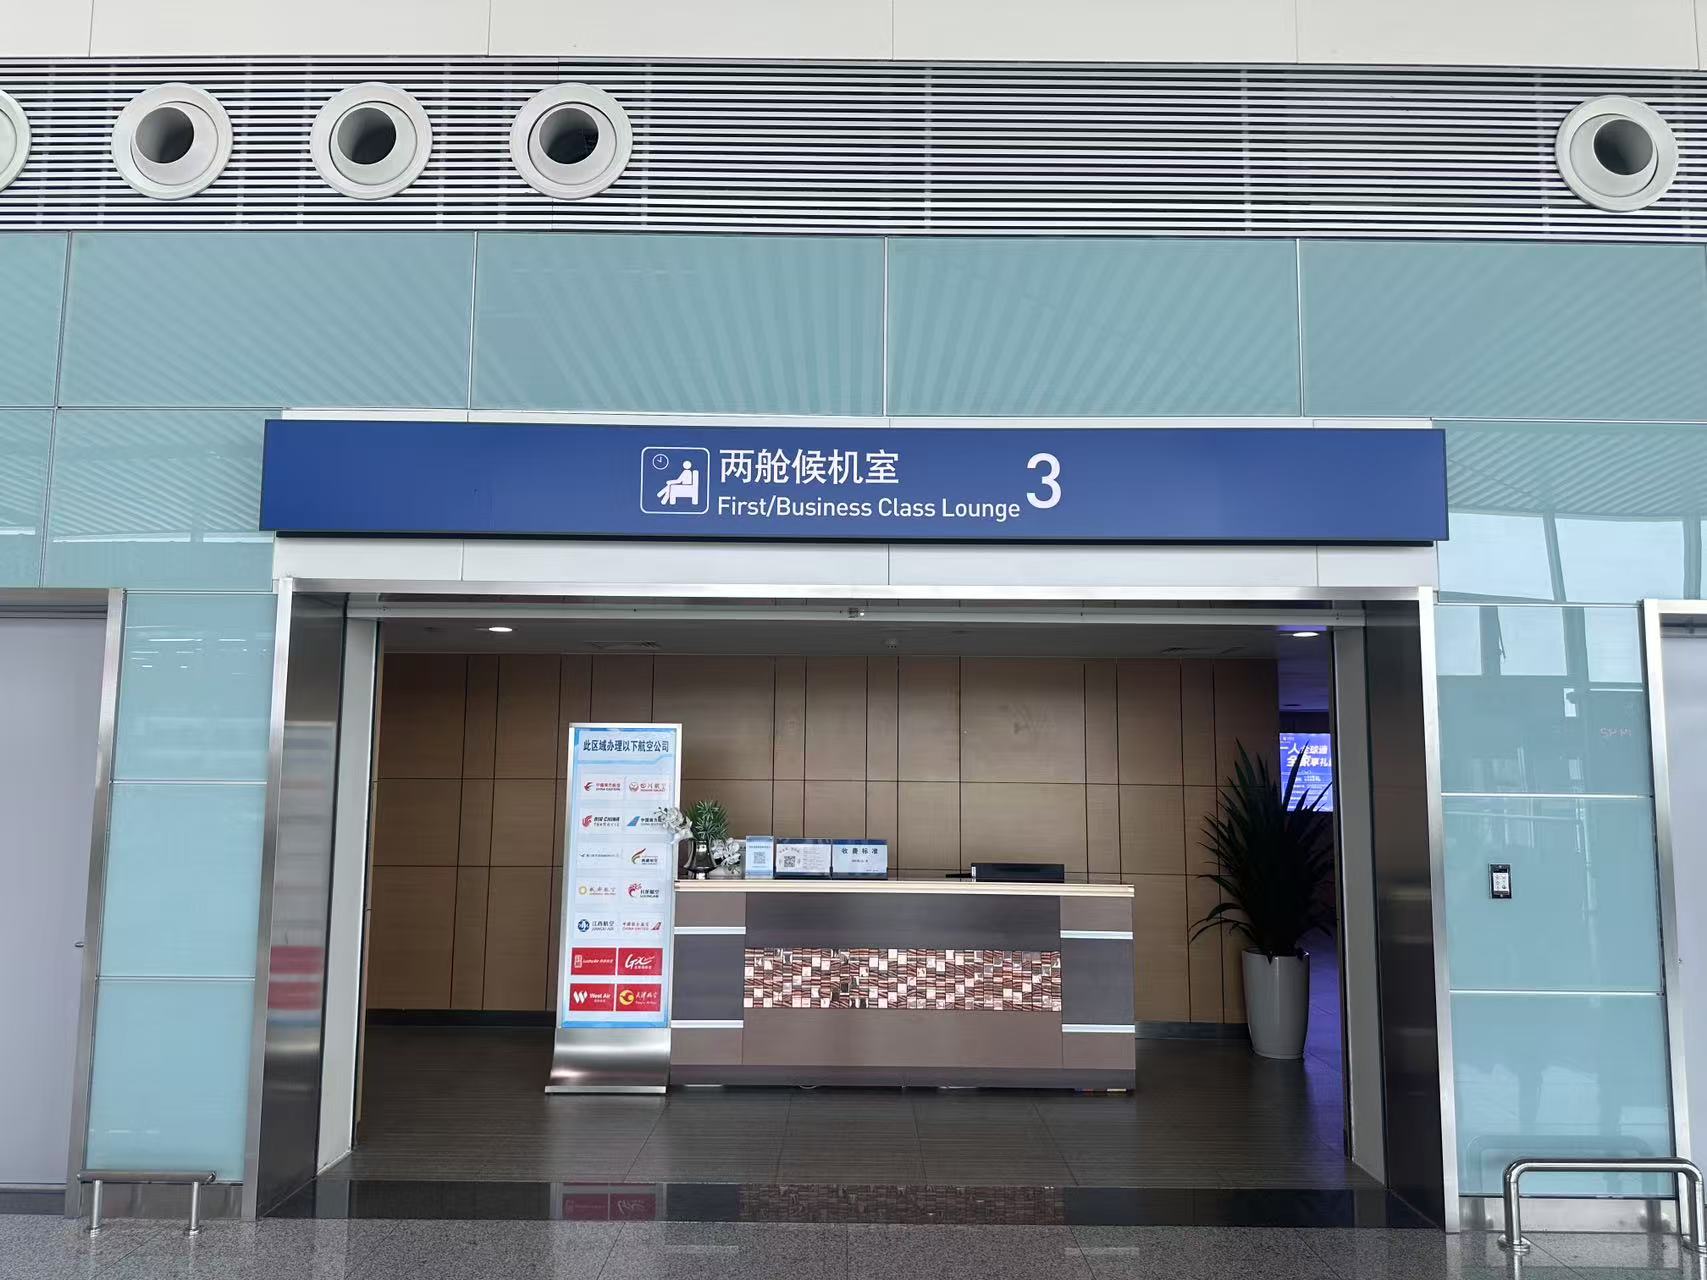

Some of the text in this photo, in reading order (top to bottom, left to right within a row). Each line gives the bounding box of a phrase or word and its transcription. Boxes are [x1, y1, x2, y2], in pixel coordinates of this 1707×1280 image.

[719, 449, 900, 485] 两舱候机室
[1026, 452, 1062, 509] 3
[718, 495, 1021, 522] First/Business Class Lounge
[583, 739, 669, 753] 此区域办理以下航空公司
[841, 847, 879, 855] 收费标准
